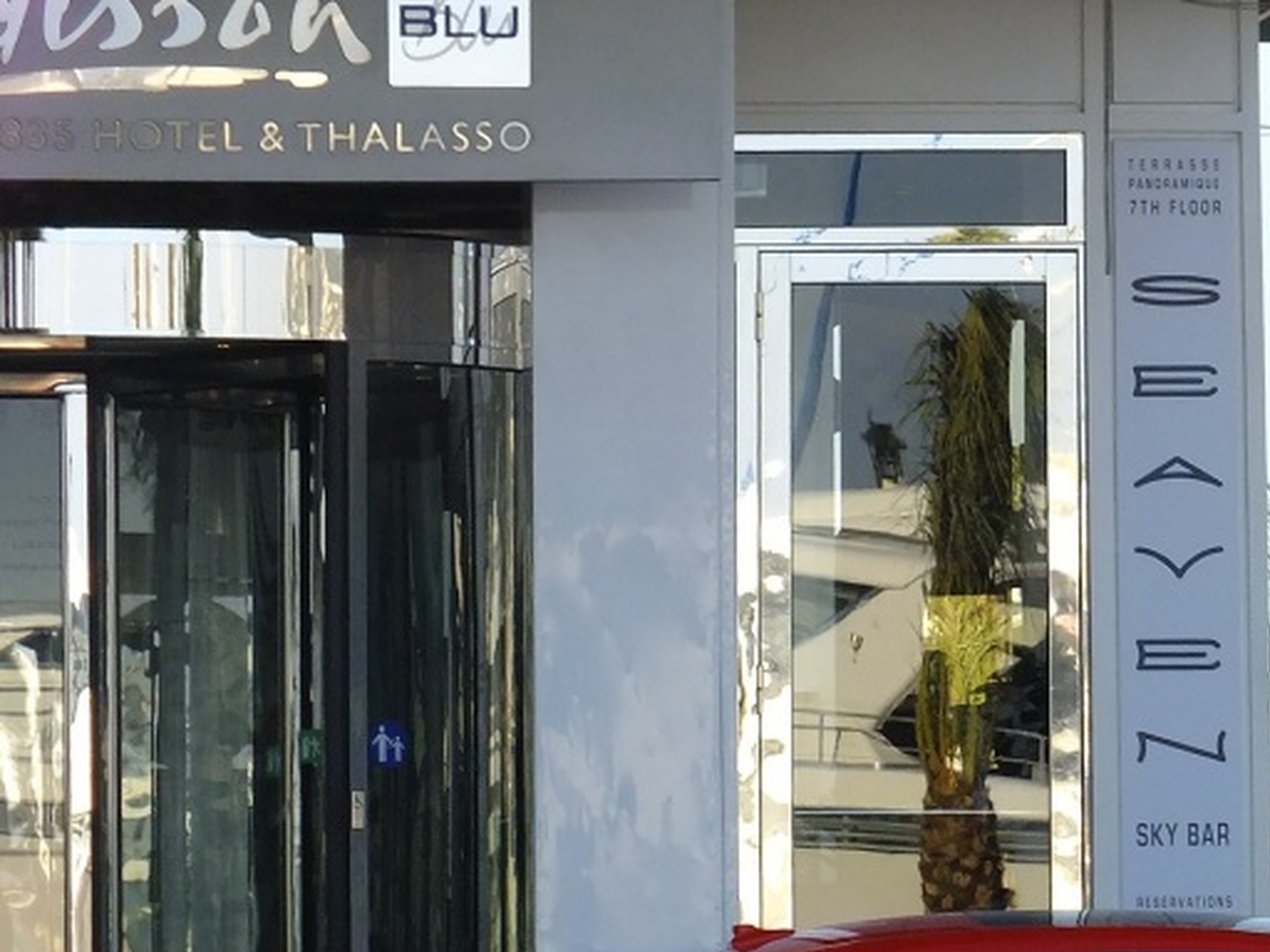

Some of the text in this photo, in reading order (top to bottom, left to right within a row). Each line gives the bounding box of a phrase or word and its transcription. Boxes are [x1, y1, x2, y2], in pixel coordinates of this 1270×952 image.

[400, 5, 518, 38] BLU
[94, 119, 243, 153] HOTEL
[259, 120, 285, 153] &
[297, 120, 532, 153] THALASSO
[1127, 157, 1220, 172] TERRASSE
[1127, 177, 1219, 190] PANORAMIQUE
[1130, 199, 1222, 216] 7TH FLOOR
[1135, 822, 1231, 847] SKY BAR
[1136, 895, 1234, 909] RESERVATIONS
